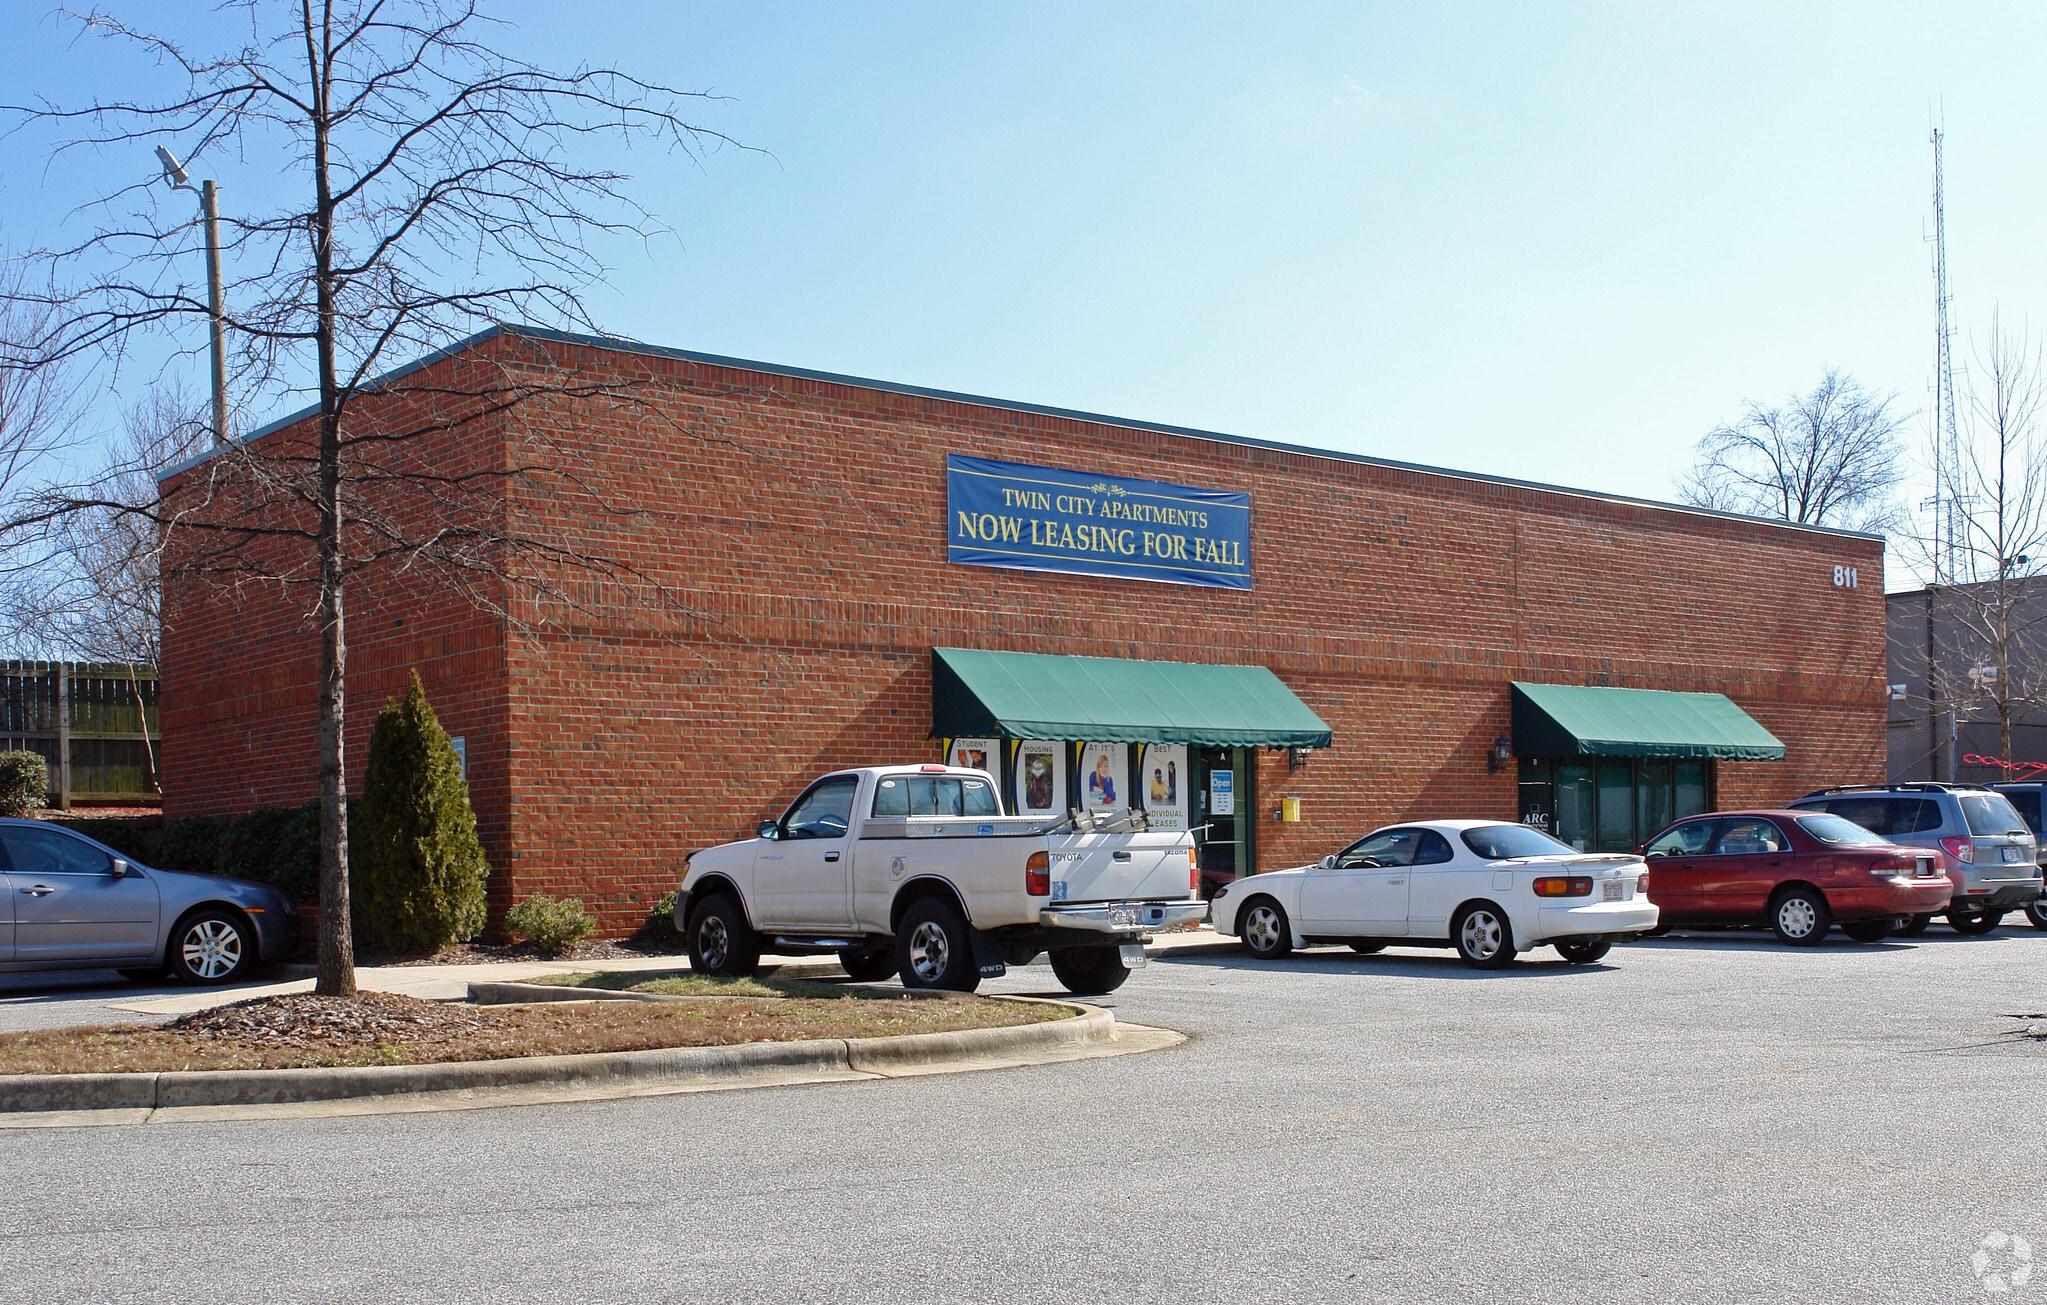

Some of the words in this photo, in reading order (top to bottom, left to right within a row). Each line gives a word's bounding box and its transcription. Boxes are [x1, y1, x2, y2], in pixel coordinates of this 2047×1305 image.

[1002, 488, 1050, 511] TWIN
[1056, 495, 1097, 516] CITY
[1100, 500, 1208, 529] APARTMENTS
[957, 511, 1023, 543] NOW
[1030, 519, 1135, 556] LEASING
[1143, 531, 1188, 561] FOR
[1195, 537, 1245, 566] FALL
[1833, 565, 1856, 588] 811
[956, 739, 987, 748] STUDENT
[1089, 743, 1098, 752] AT
[1101, 744, 1115, 752] IT'S
[1024, 745, 1053, 753] HOUSING
[1153, 744, 1171, 753] BEST
[1220, 752, 1226, 761] A
[1213, 778, 1231, 789] Open
[1522, 813, 1548, 824] ARC
[1051, 853, 1082, 862] TOYOTA
[980, 964, 1003, 973] 4WD
